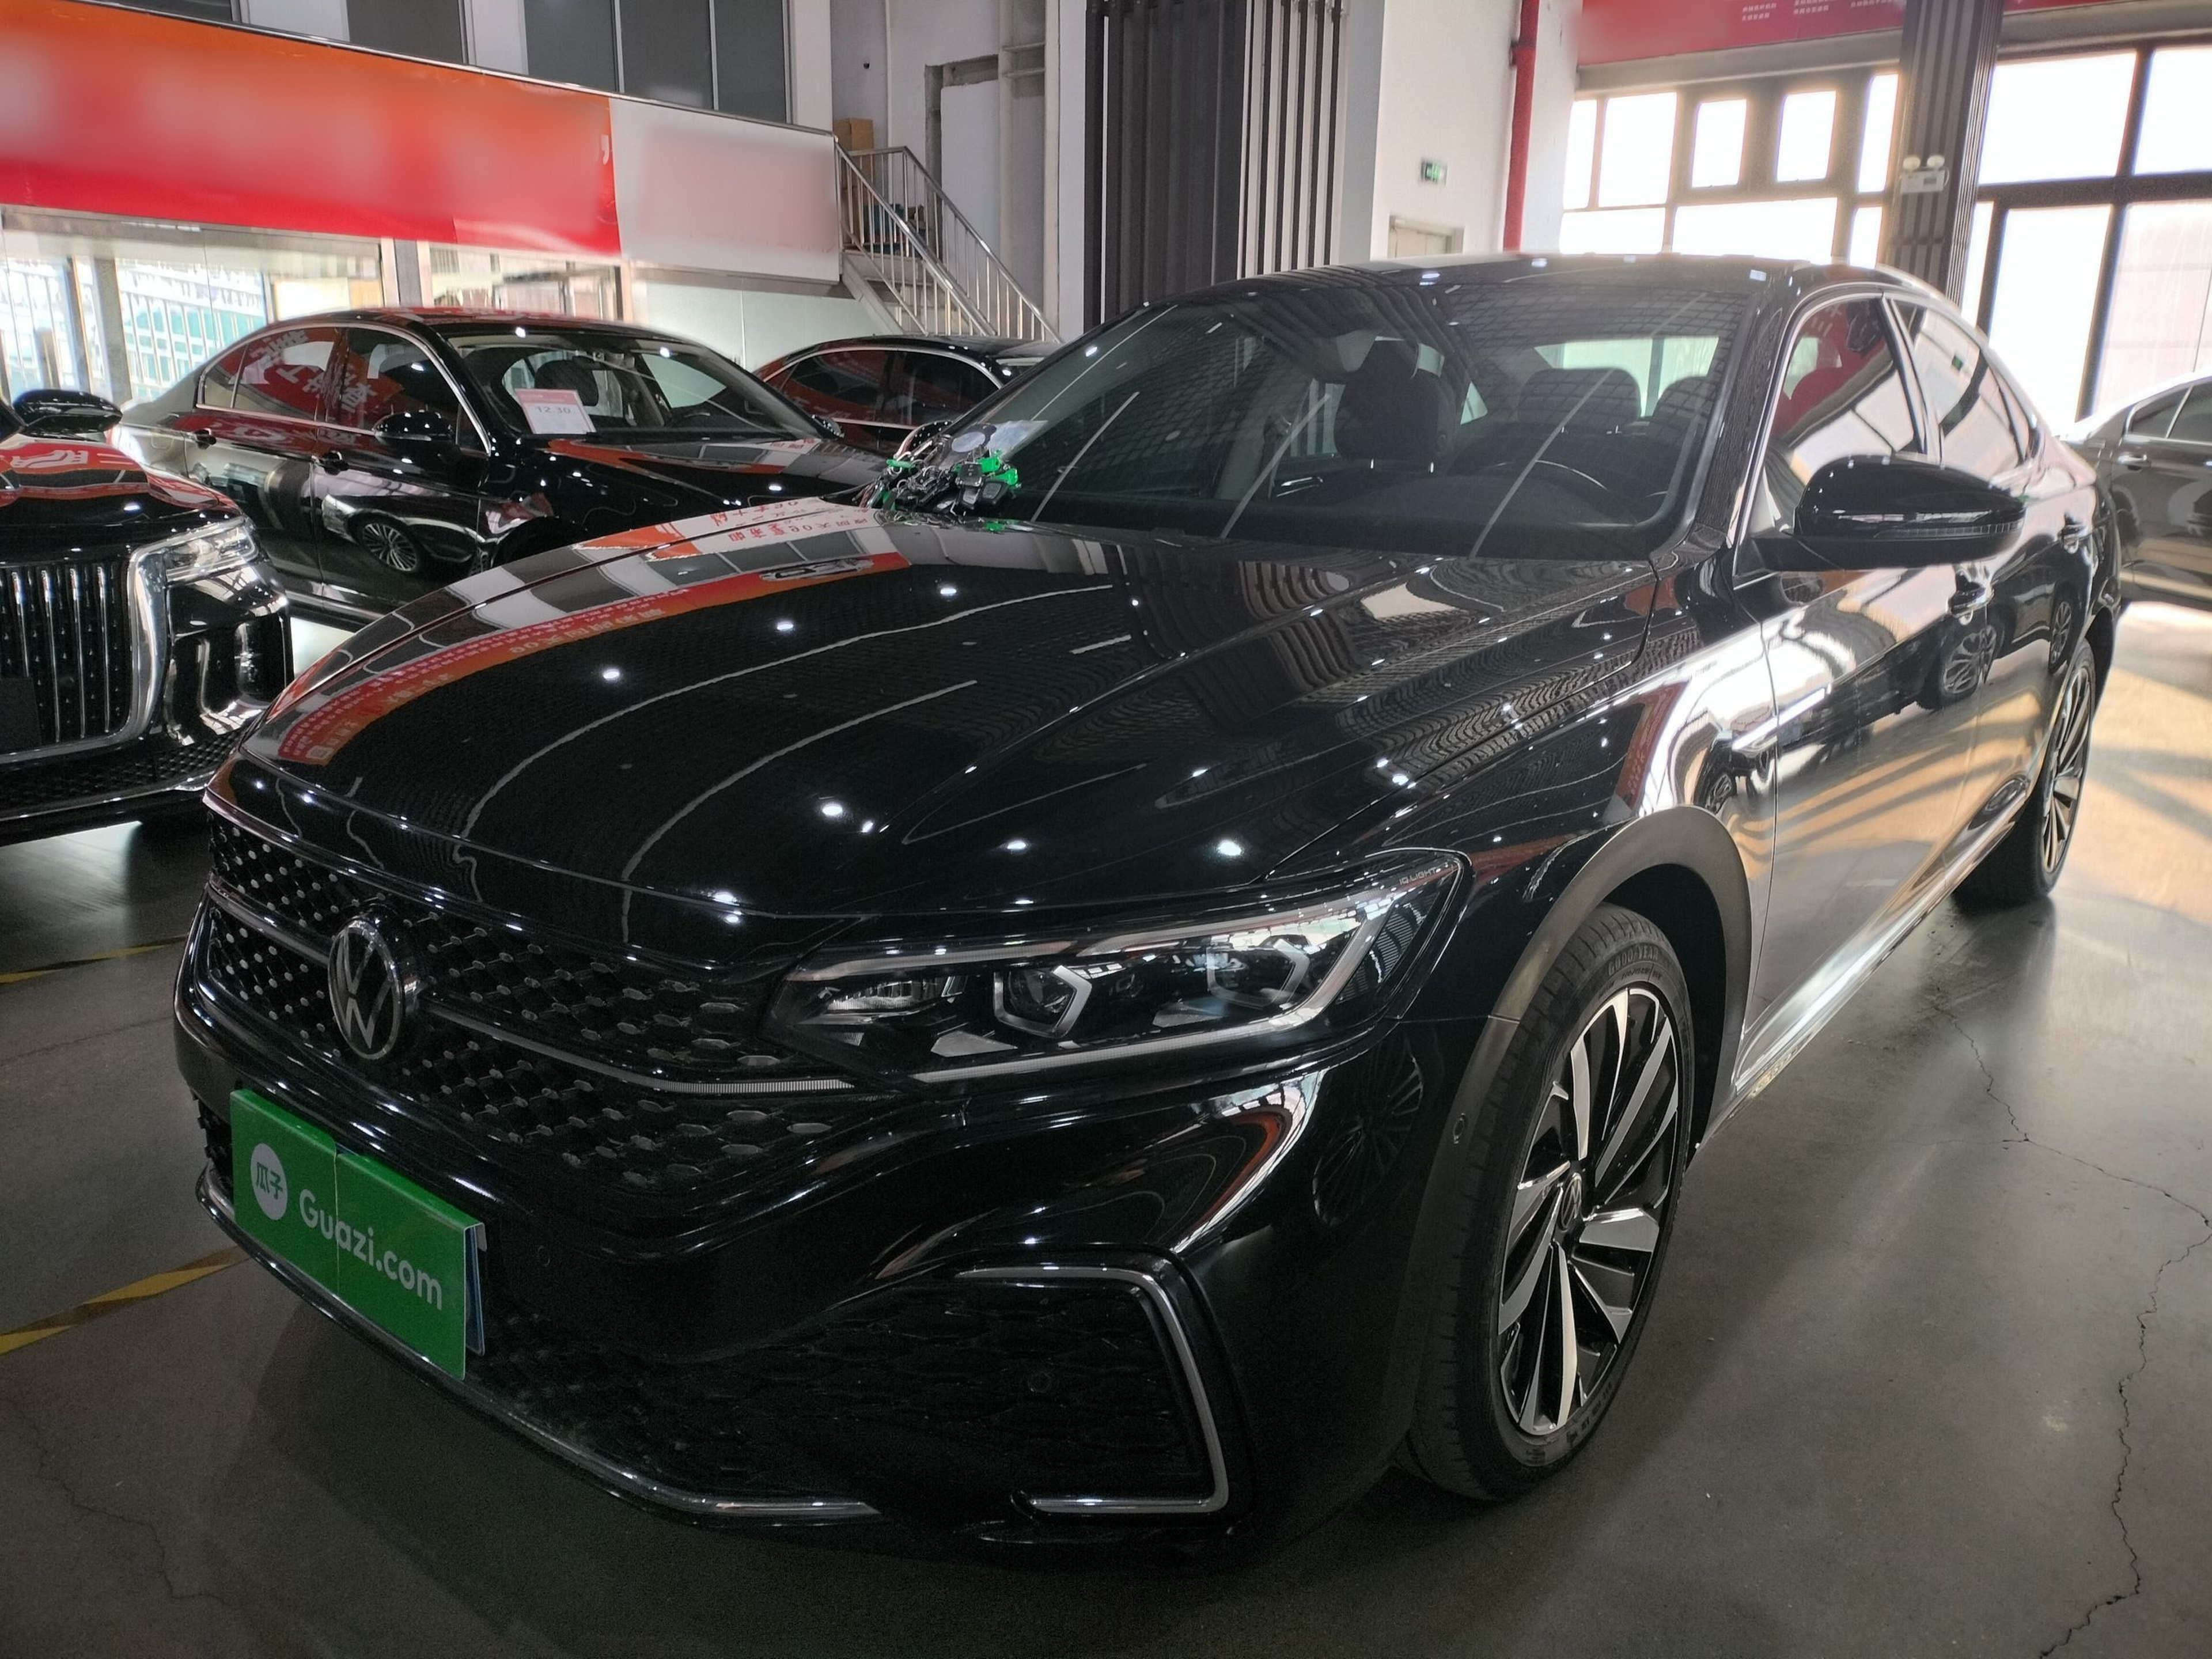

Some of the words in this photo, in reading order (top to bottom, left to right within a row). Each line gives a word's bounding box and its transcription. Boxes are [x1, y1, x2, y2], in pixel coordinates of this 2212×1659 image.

[1399, 867, 1436, 885] IQ.LIGHT
[255, 1161, 283, 1199] 瓜子
[299, 1188, 443, 1310] Guazi.com
